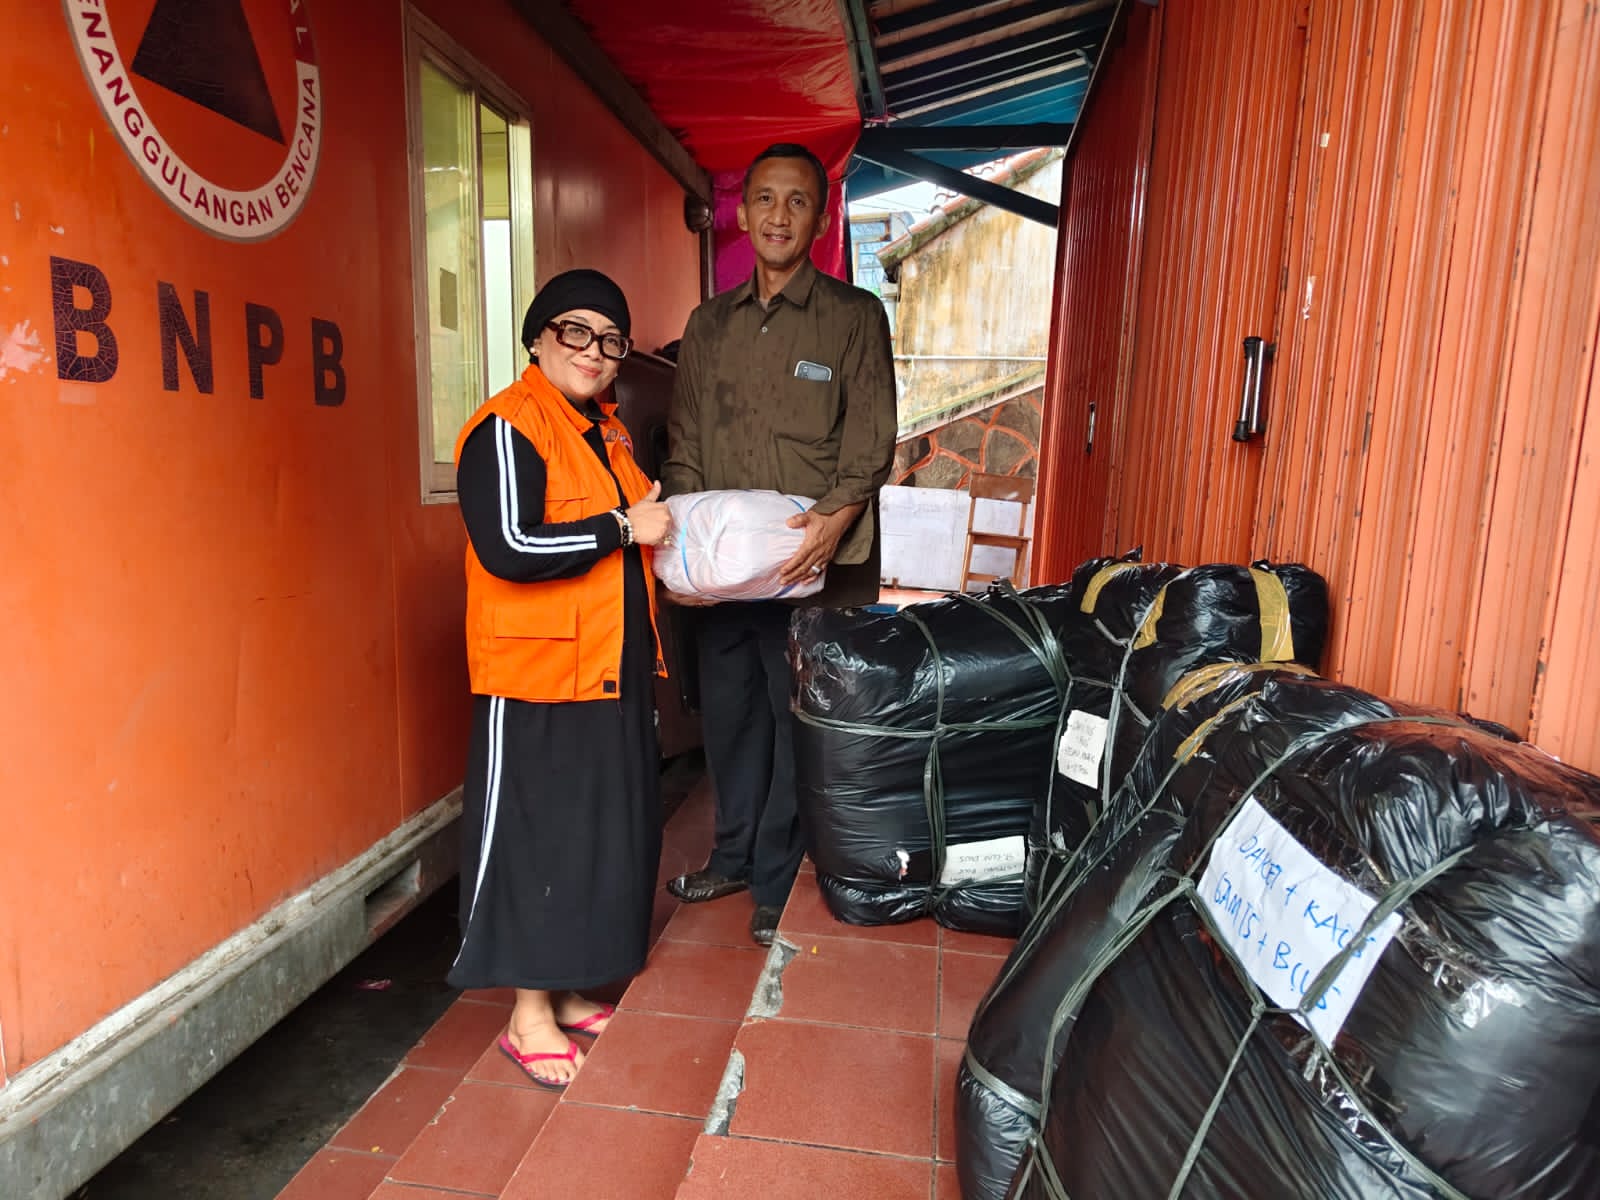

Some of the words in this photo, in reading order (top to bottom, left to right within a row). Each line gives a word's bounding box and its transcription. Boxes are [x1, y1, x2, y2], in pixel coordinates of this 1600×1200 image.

[78, 0, 273, 227] NANGGULANGAN
[277, 77, 315, 209] BENCANA
[50, 256, 347, 407] BNPB
